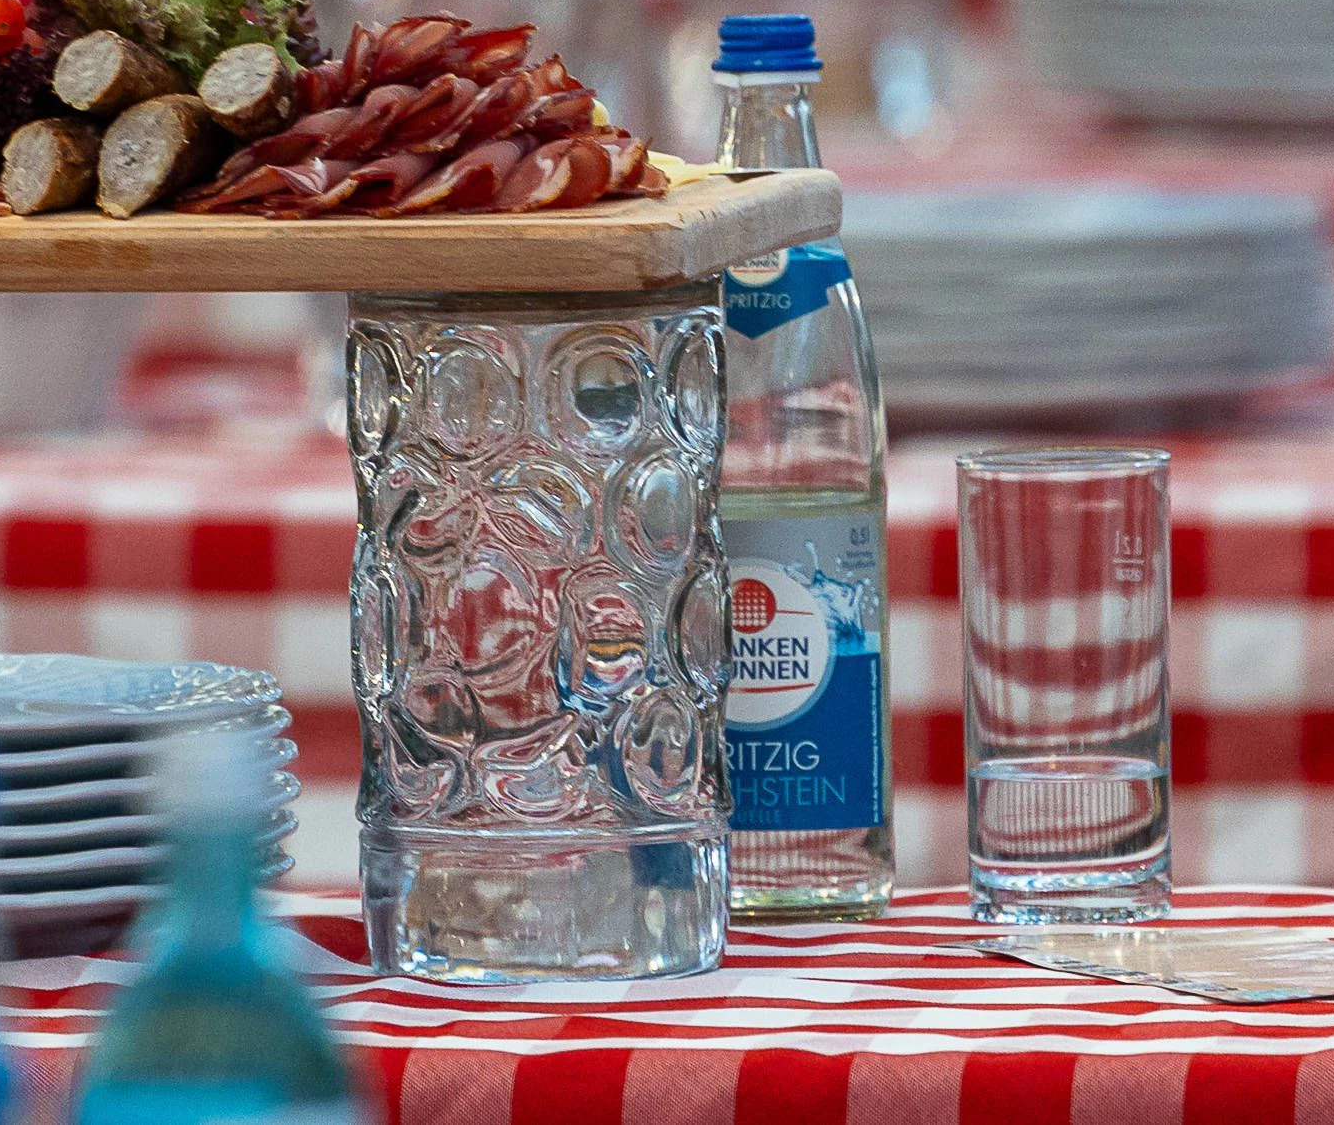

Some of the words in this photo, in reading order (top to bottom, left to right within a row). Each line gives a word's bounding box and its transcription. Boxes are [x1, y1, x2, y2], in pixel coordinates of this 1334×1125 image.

[727, 291, 792, 310] PRITZIG
[726, 740, 820, 772] RITZIG
[736, 775, 846, 806] HSTEIN
